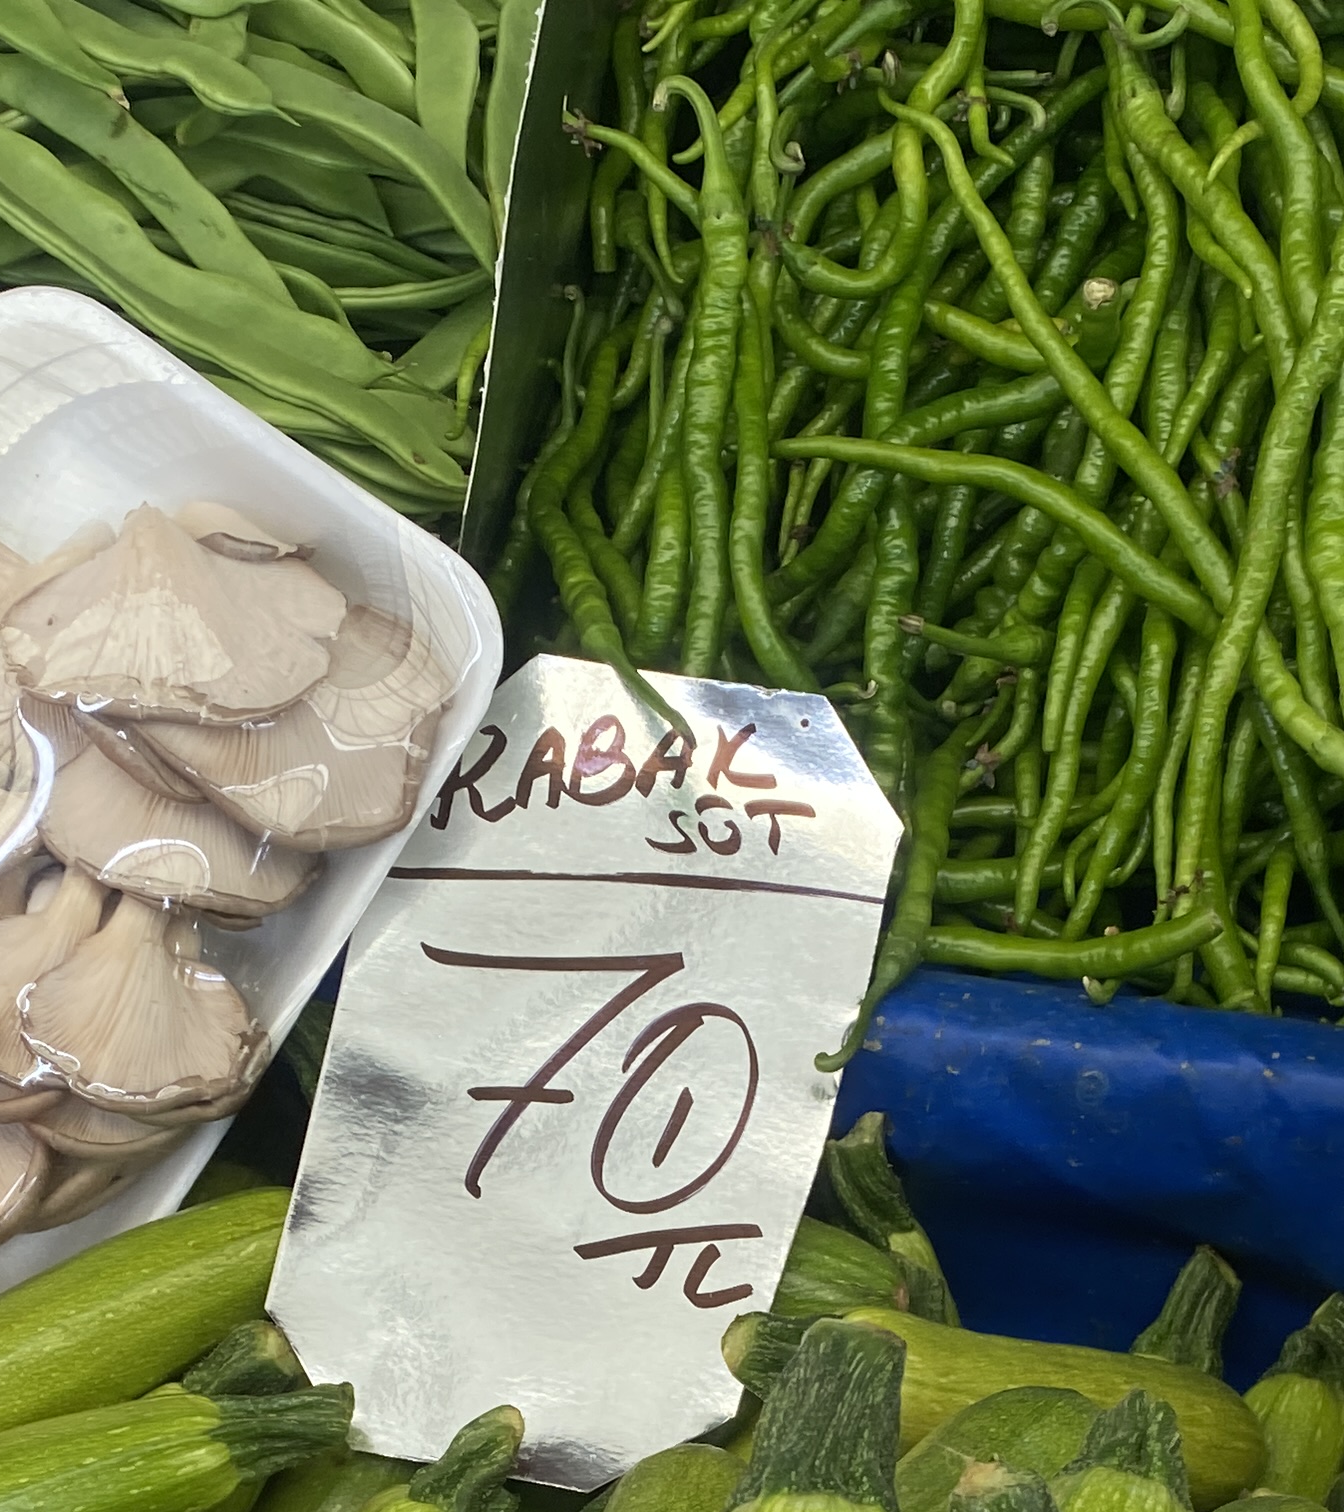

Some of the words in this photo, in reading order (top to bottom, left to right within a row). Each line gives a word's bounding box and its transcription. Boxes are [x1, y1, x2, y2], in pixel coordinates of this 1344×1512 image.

[430, 713, 778, 830] KABAK
[420, 941, 761, 1214] 70
[573, 1222, 763, 1309] TL
